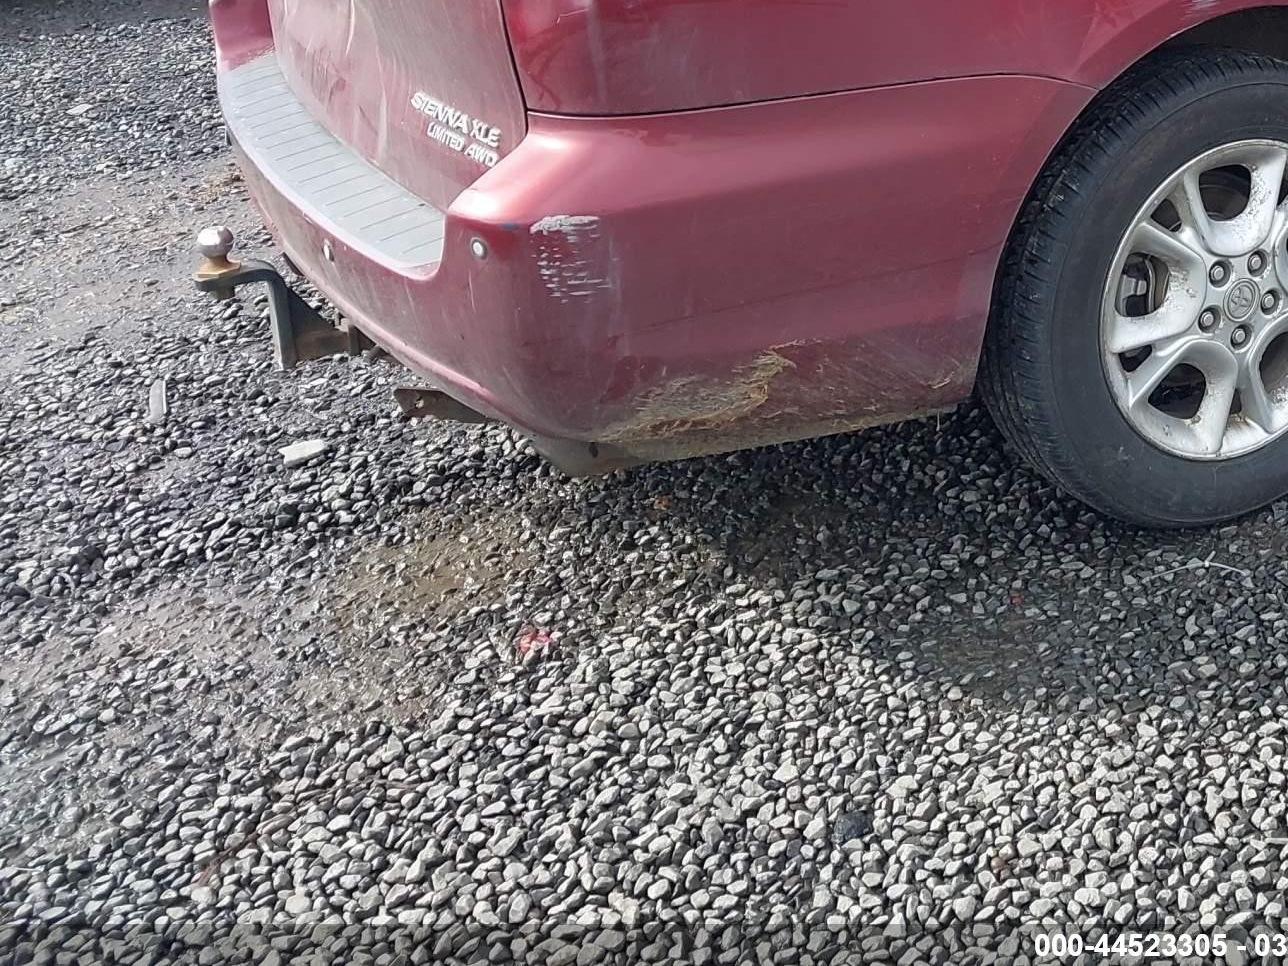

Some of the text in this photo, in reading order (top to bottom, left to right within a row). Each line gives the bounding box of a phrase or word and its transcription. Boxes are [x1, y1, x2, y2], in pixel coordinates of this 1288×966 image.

[411, 91, 501, 148] SIENNA XLE
[426, 121, 500, 167] LIMITED AWD
